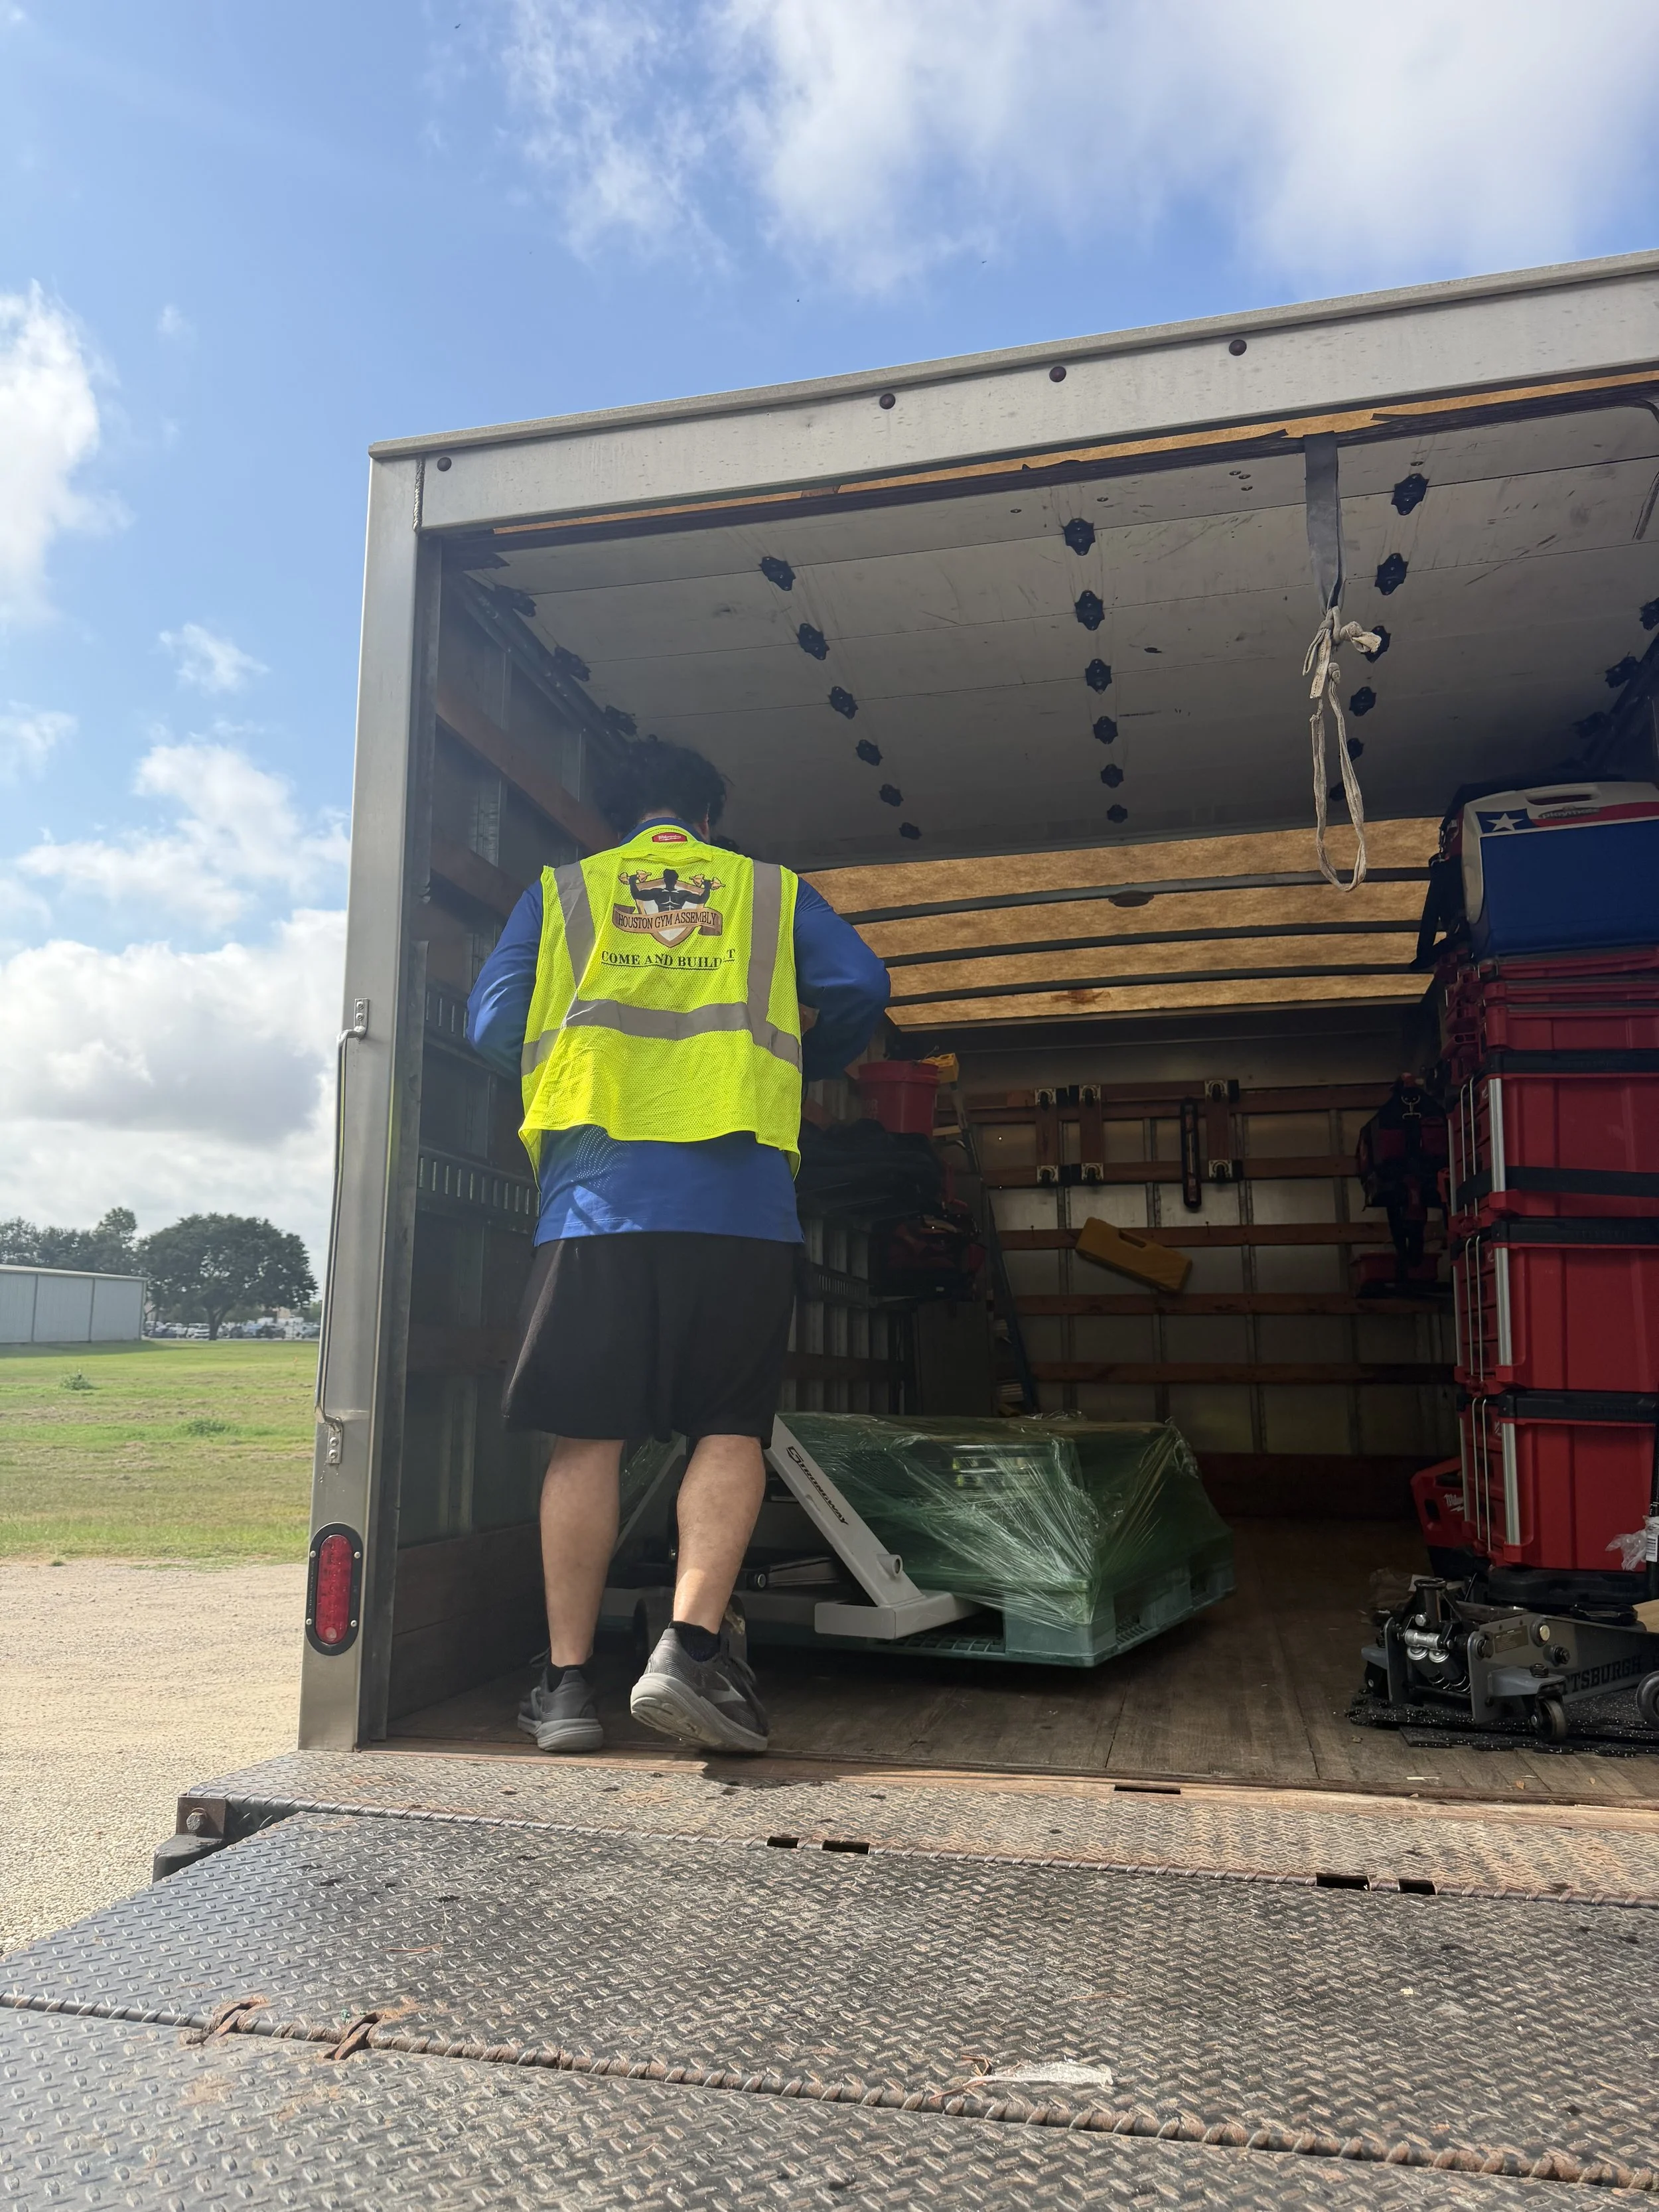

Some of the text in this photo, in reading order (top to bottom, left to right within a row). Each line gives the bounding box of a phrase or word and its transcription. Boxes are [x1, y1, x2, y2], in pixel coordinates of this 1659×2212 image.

[618, 911, 717, 929] HOUSTON GYM ASSEMBLY
[601, 948, 736, 968] COME AND BUILD T
